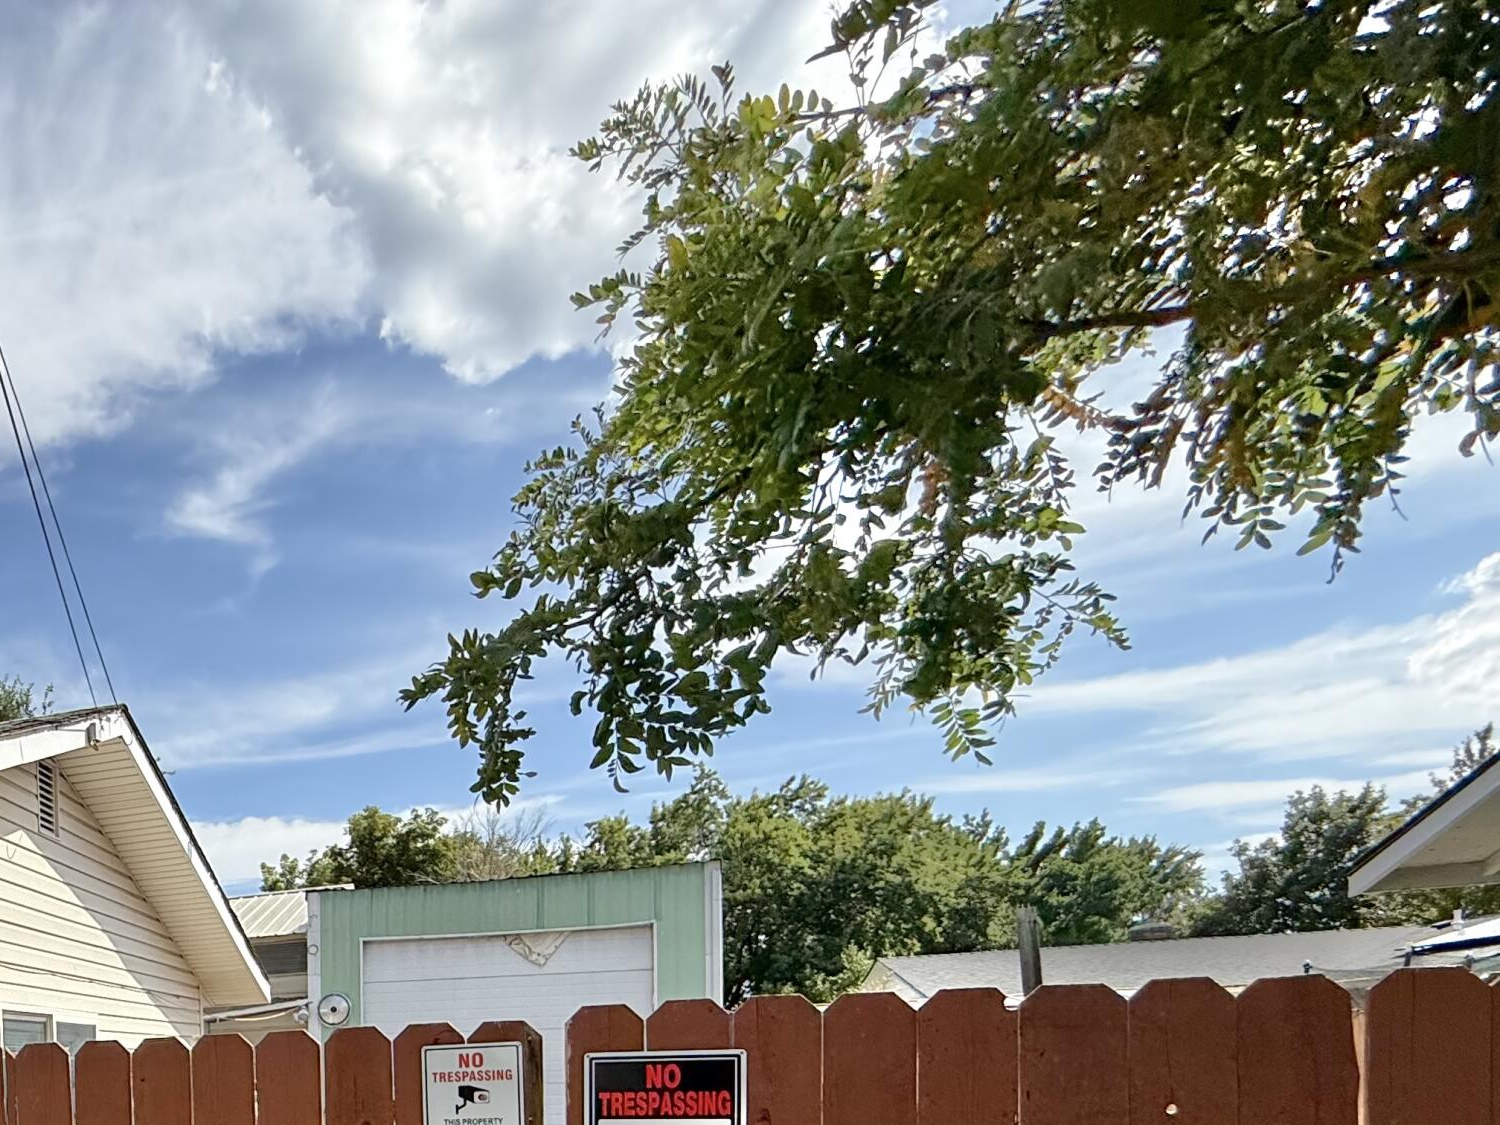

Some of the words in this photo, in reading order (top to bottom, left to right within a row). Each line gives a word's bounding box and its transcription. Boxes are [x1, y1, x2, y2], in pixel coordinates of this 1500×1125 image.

[458, 1052, 484, 1069] NO
[431, 1069, 513, 1083] TRESPASSING
[645, 1063, 681, 1089] NO
[599, 1091, 732, 1117] TRESPASSING
[444, 1118, 460, 1125] THIS
[462, 1117, 503, 1125] PROPERTY
